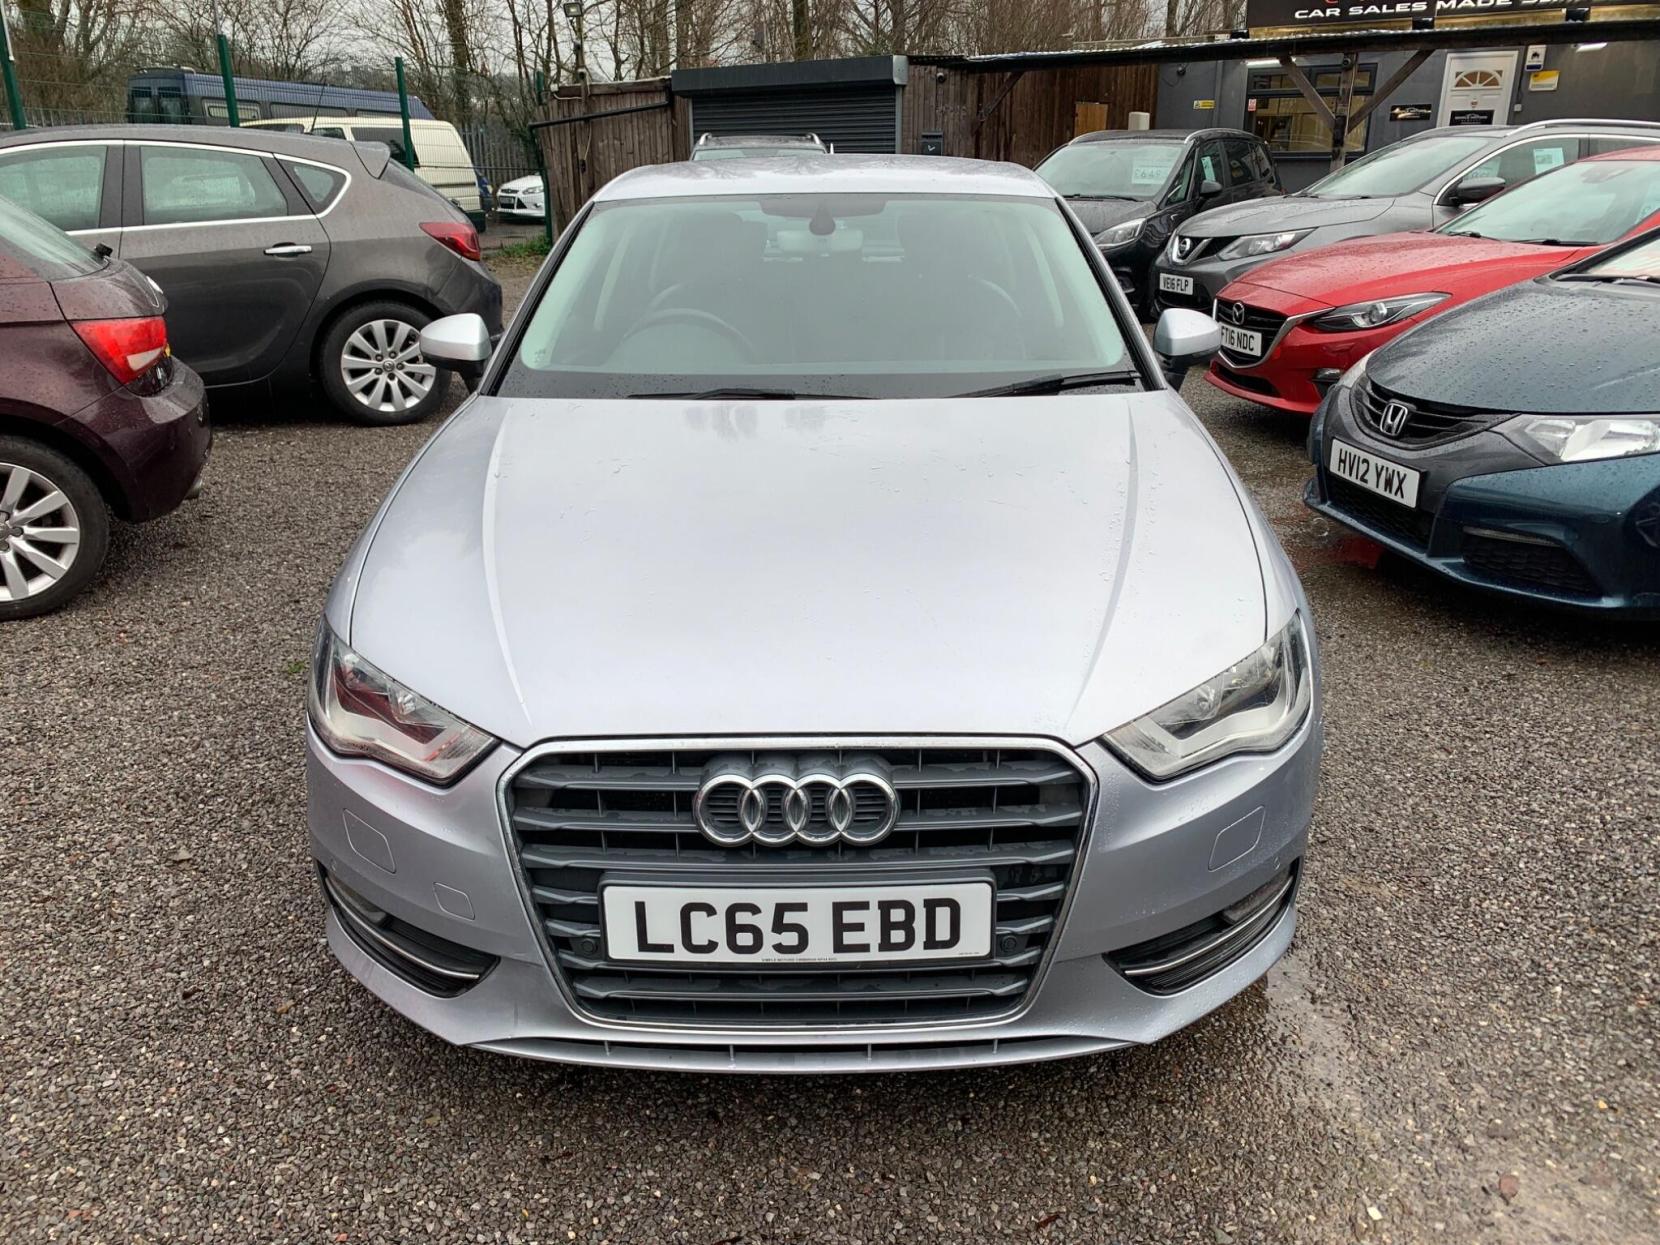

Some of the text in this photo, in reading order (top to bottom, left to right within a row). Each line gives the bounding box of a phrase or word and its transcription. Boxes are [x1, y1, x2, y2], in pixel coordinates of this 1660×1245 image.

[1294, 0, 1512, 19] CAR SALES MADE
[1163, 276, 1189, 292] VE16 FLP
[1221, 325, 1255, 352] FT16 NDC
[1338, 448, 1407, 499] HV12 YWX
[634, 897, 962, 955] LC65 EBD
